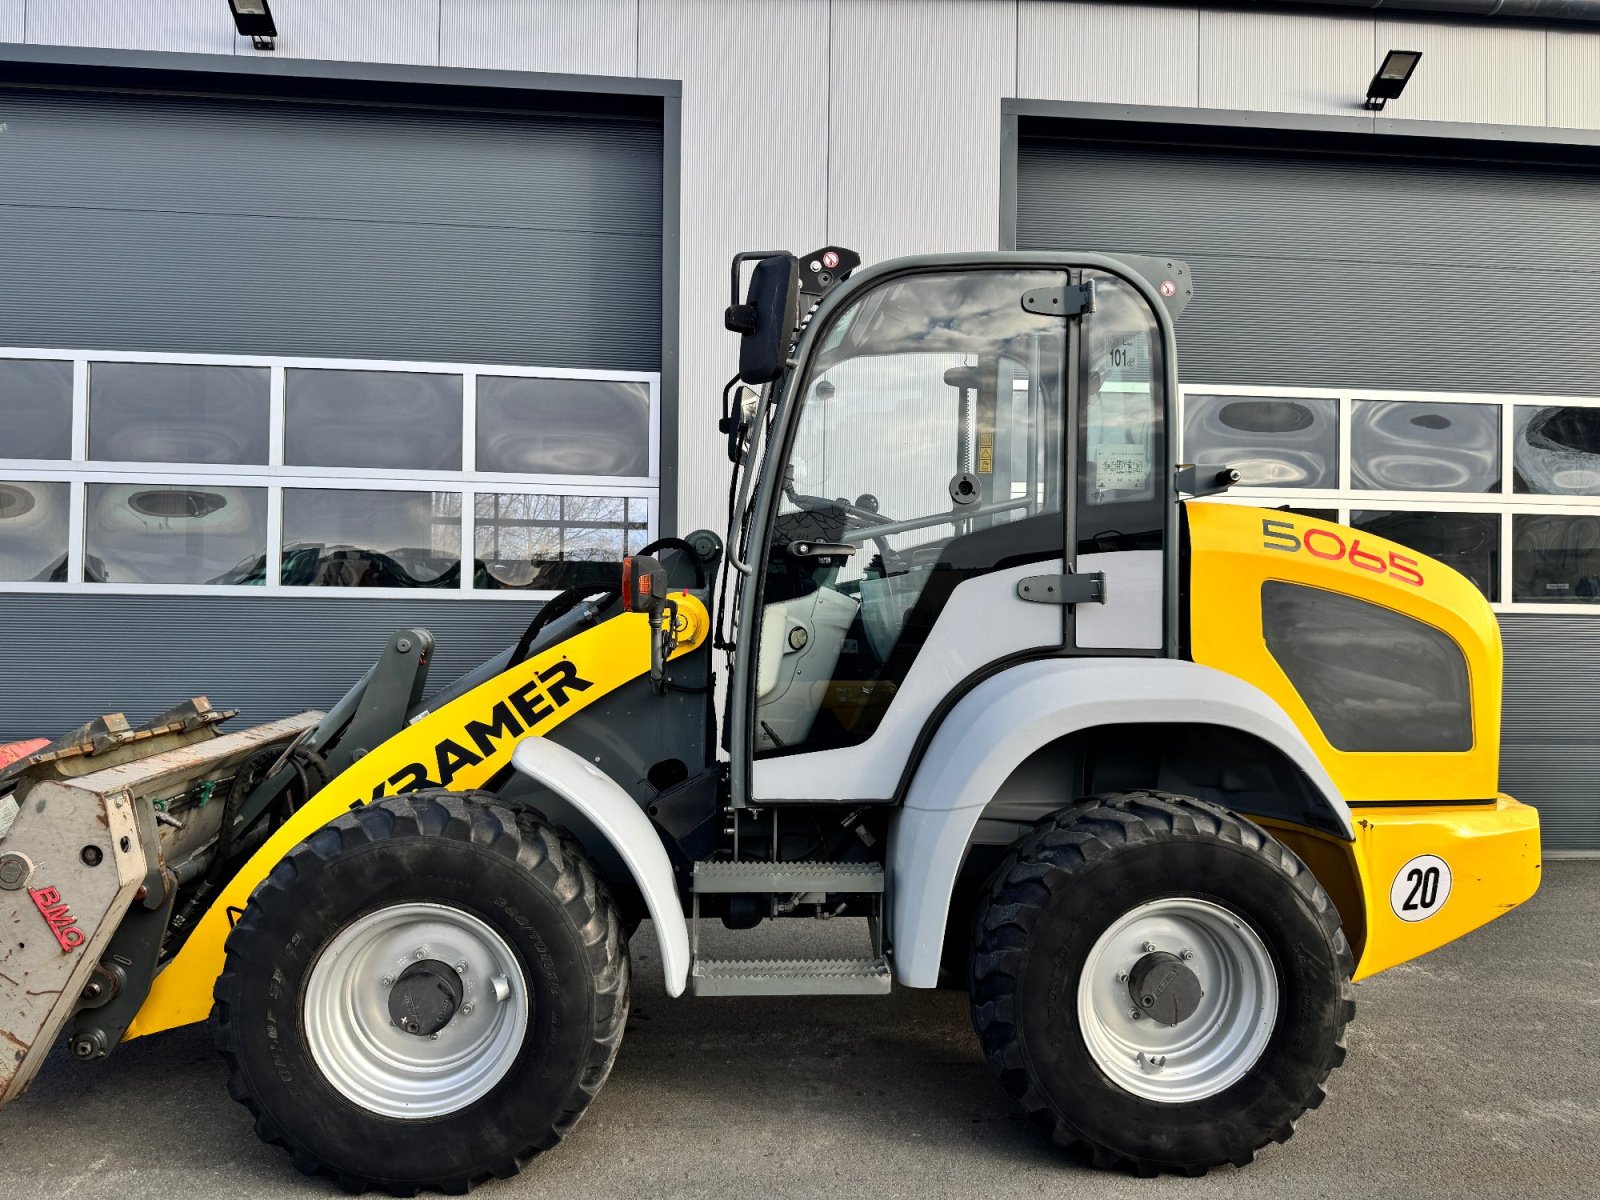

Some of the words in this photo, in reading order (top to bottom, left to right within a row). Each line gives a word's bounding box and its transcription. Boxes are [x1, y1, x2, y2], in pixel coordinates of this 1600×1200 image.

[1109, 348, 1126, 367] 101
[1262, 519, 1424, 587] 5065
[1402, 866, 1440, 911] 20
[28, 886, 86, 953] BMO
